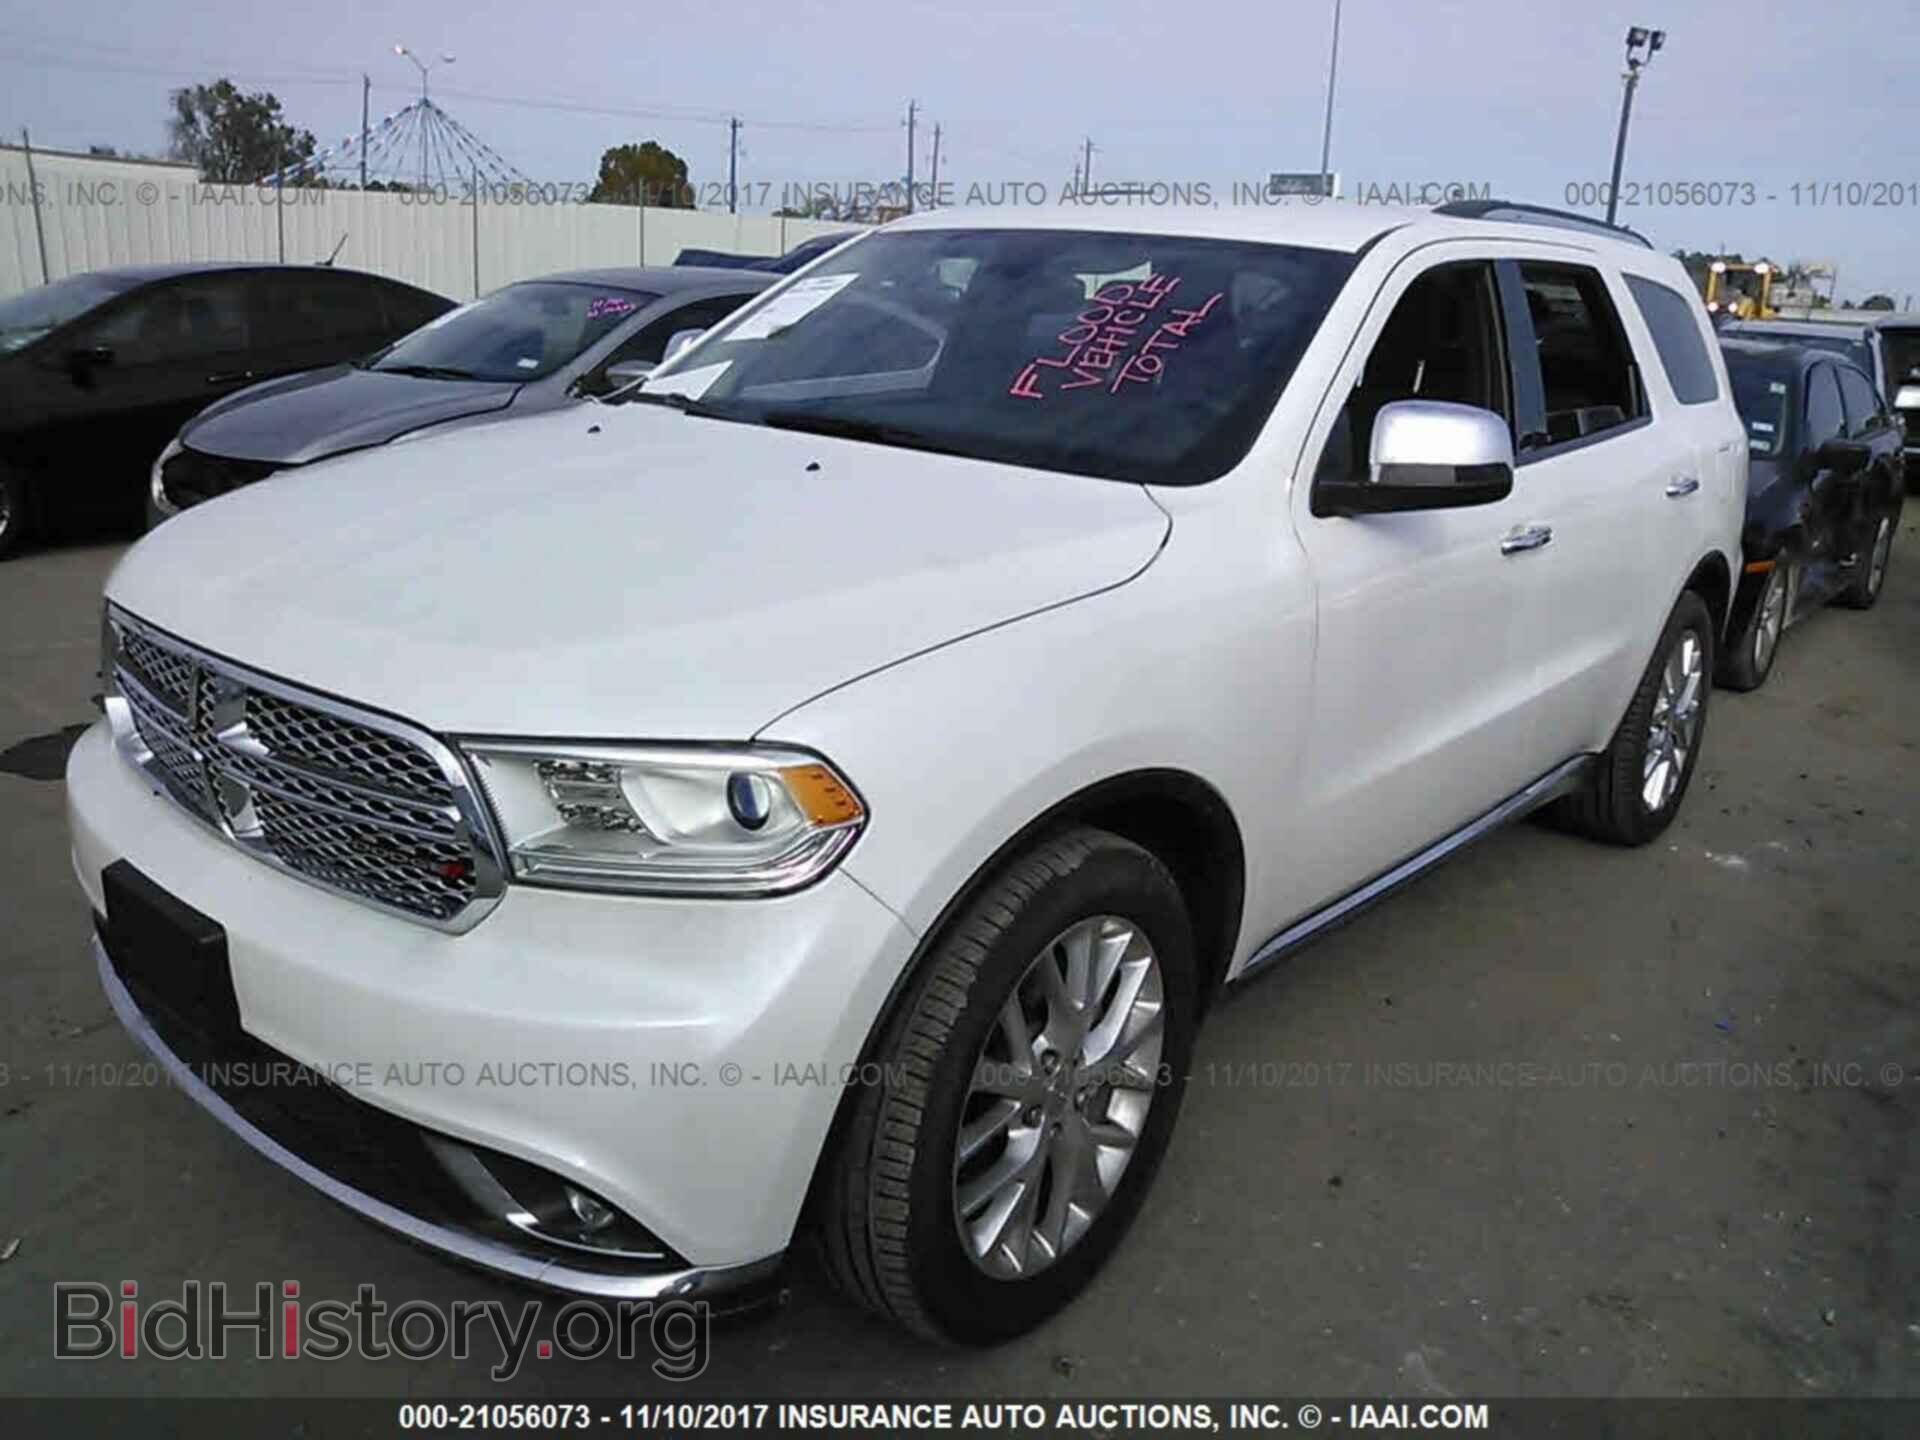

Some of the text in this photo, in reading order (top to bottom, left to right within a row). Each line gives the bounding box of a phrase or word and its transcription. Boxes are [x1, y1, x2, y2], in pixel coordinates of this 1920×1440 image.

[1010, 284, 1133, 398] FLOOD
[1061, 273, 1181, 389] VEHICLE
[1111, 293, 1224, 393] TOTAL
